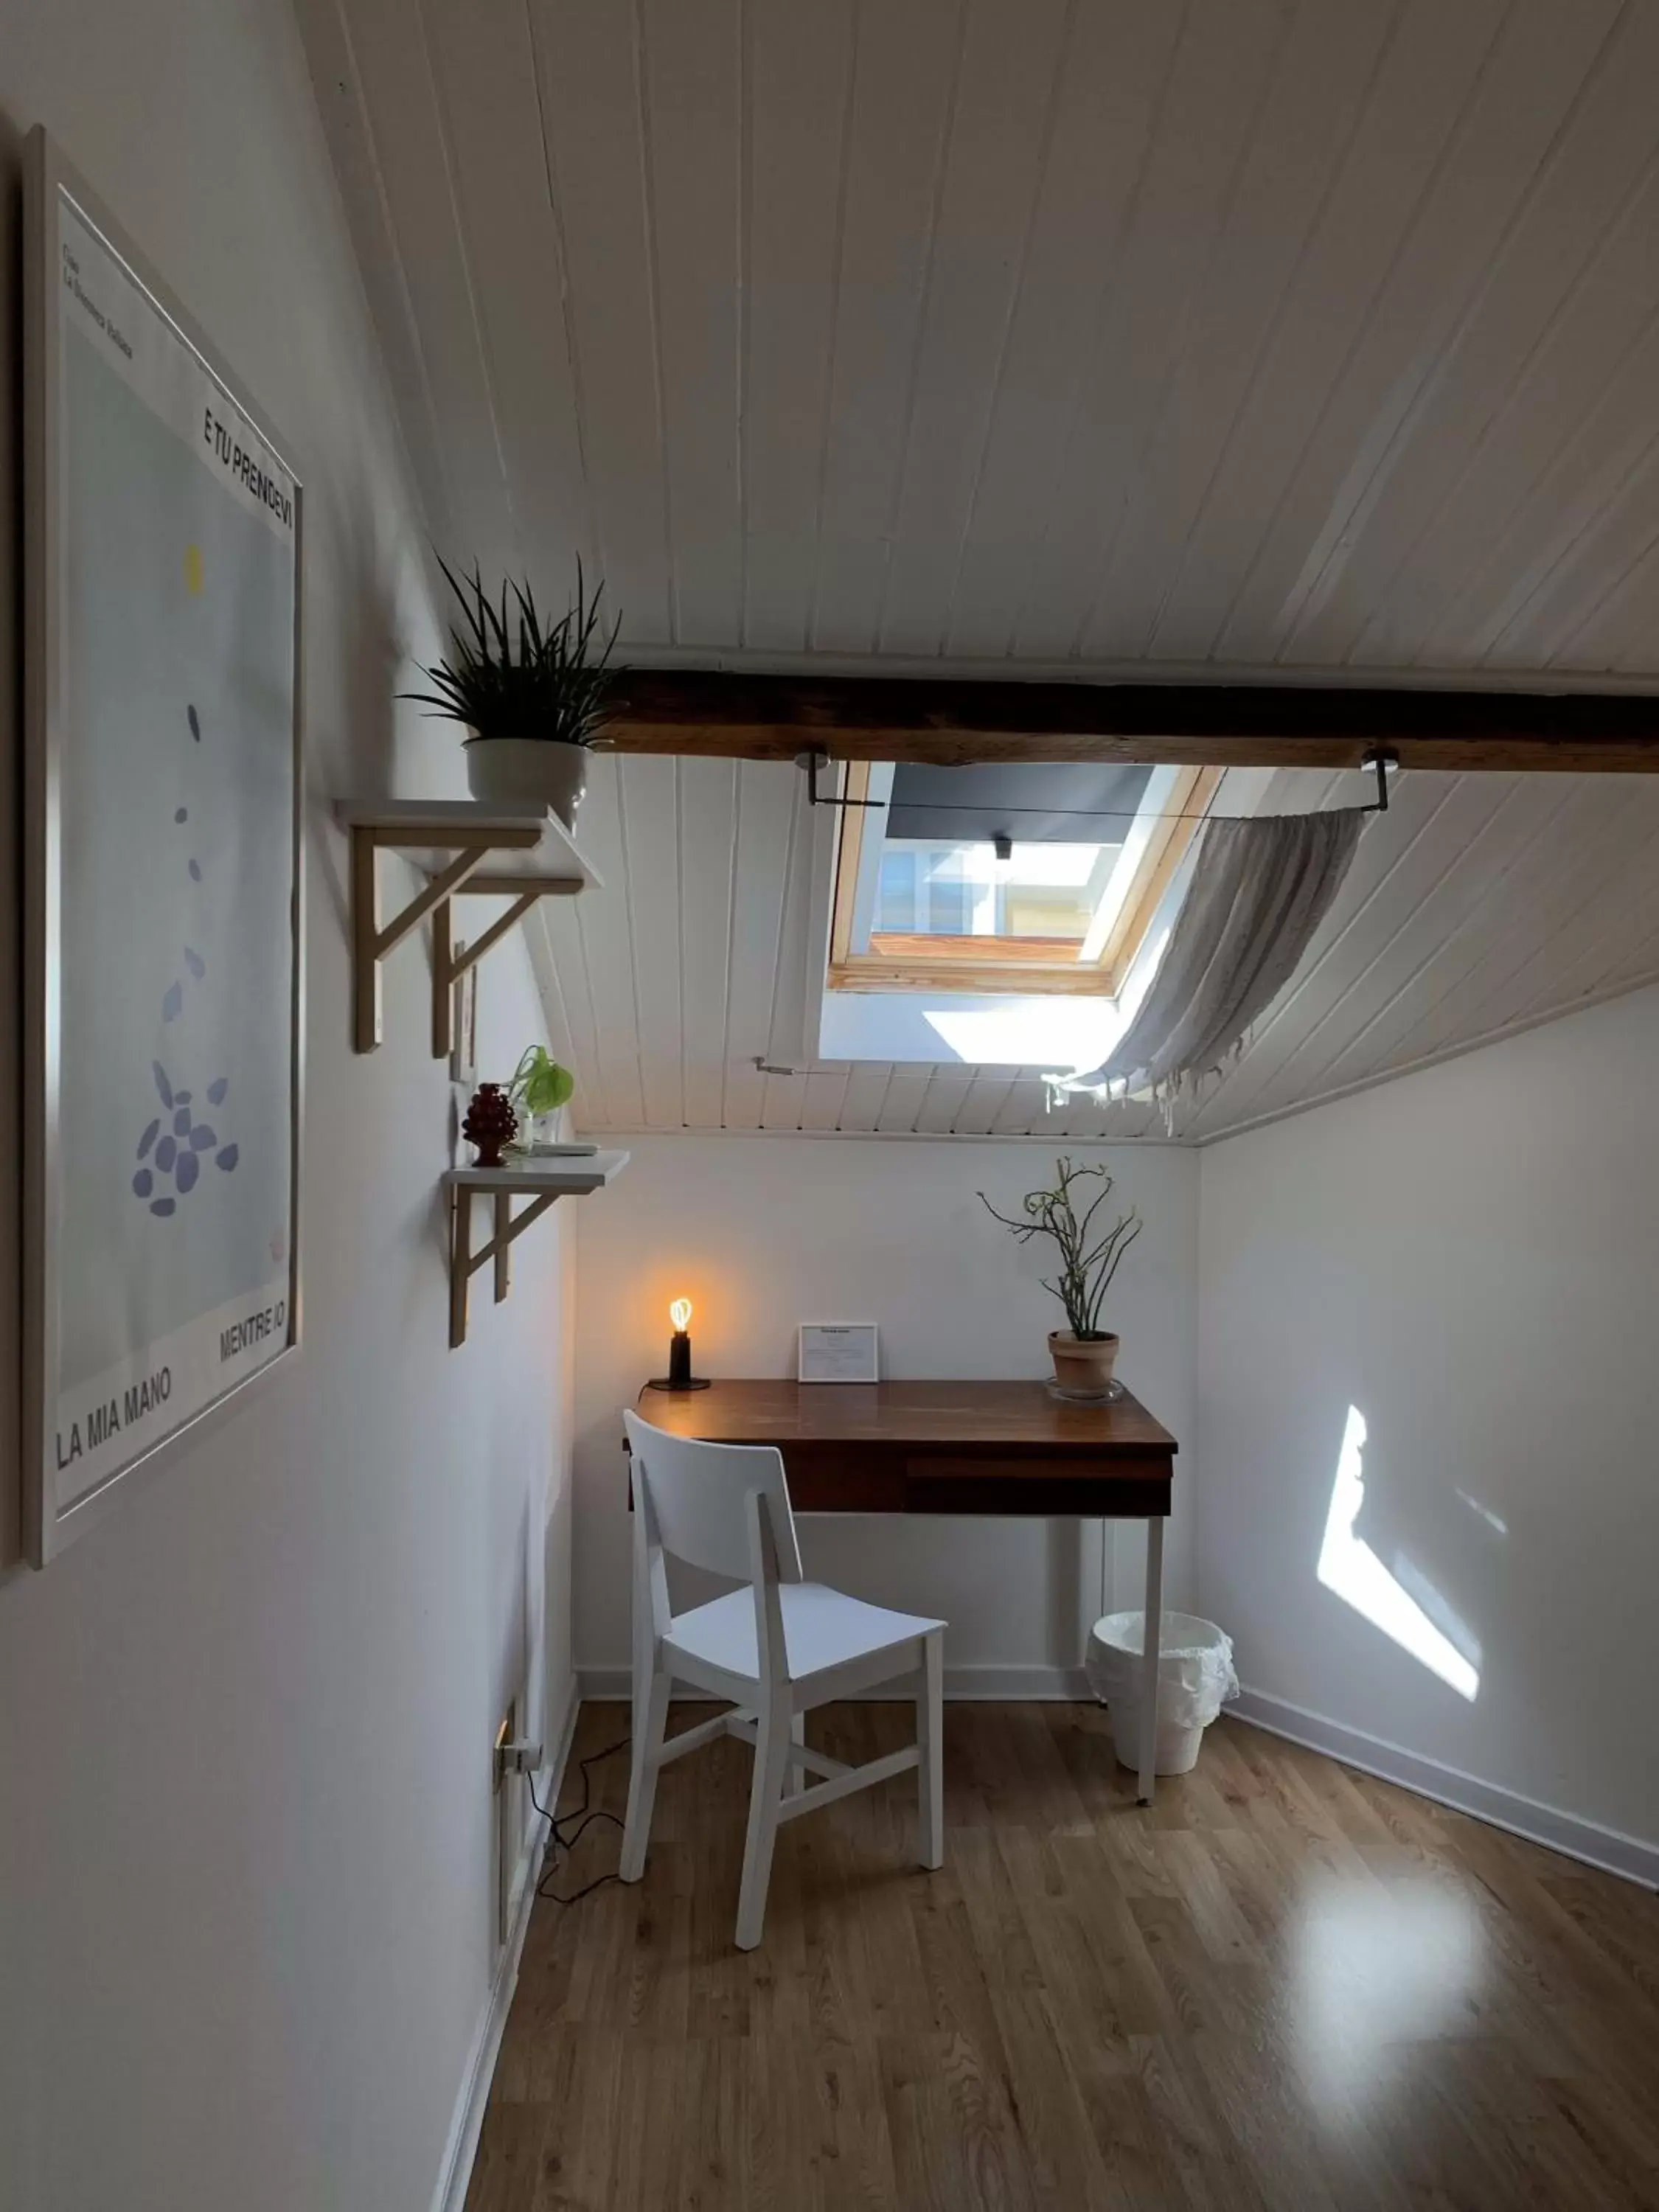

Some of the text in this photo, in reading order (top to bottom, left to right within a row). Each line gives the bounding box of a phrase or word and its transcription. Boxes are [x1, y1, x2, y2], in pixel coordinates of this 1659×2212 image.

[204, 407, 293, 531] E TU PRENDEVI
[220, 1300, 285, 1363] MENTRE IO
[56, 1366, 170, 1471] LA MIA MANO
